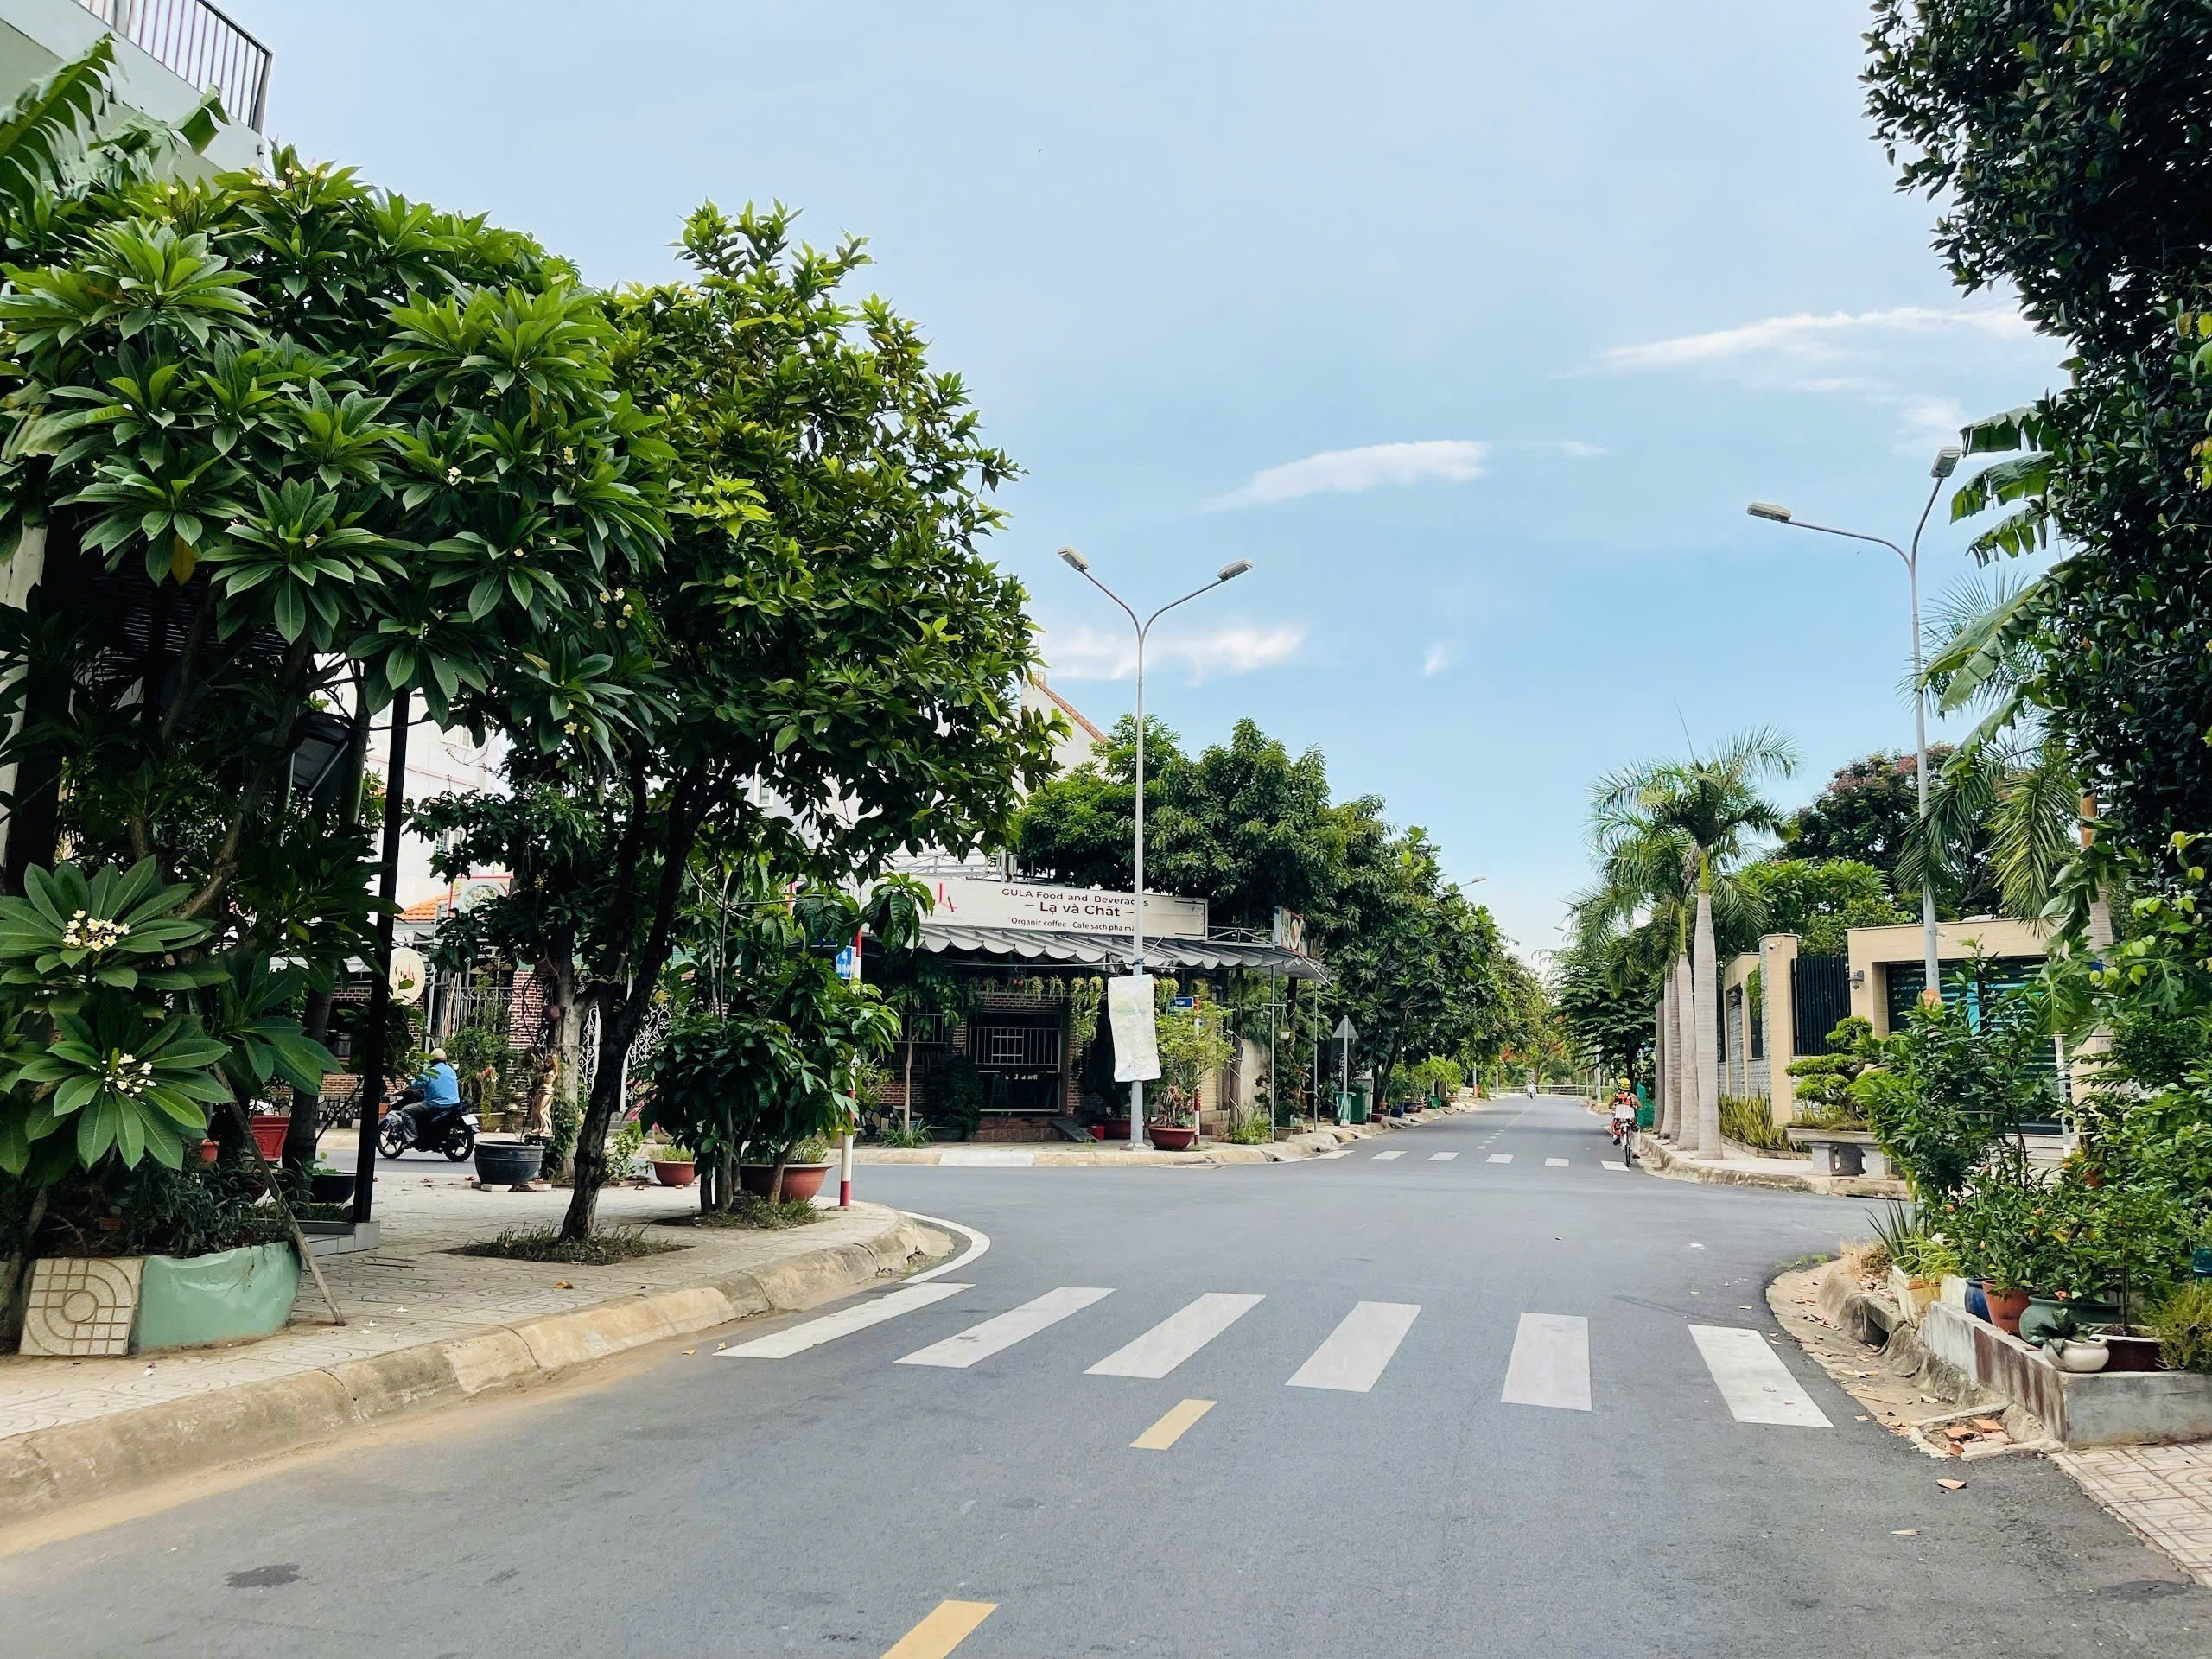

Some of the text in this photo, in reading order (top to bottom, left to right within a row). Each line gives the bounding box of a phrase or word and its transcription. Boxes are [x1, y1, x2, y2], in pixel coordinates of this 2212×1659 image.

[1001, 888, 1033, 898] GULA
[1037, 891, 1064, 900] Food
[1094, 895, 1149, 907] Beverags
[1039, 901, 1058, 915] Lạ
[1063, 903, 1079, 914] và
[1084, 904, 1121, 917] Chất
[1043, 919, 1067, 928] coffee
[1072, 921, 1090, 930] Cafe
[1109, 924, 1123, 932] pha
